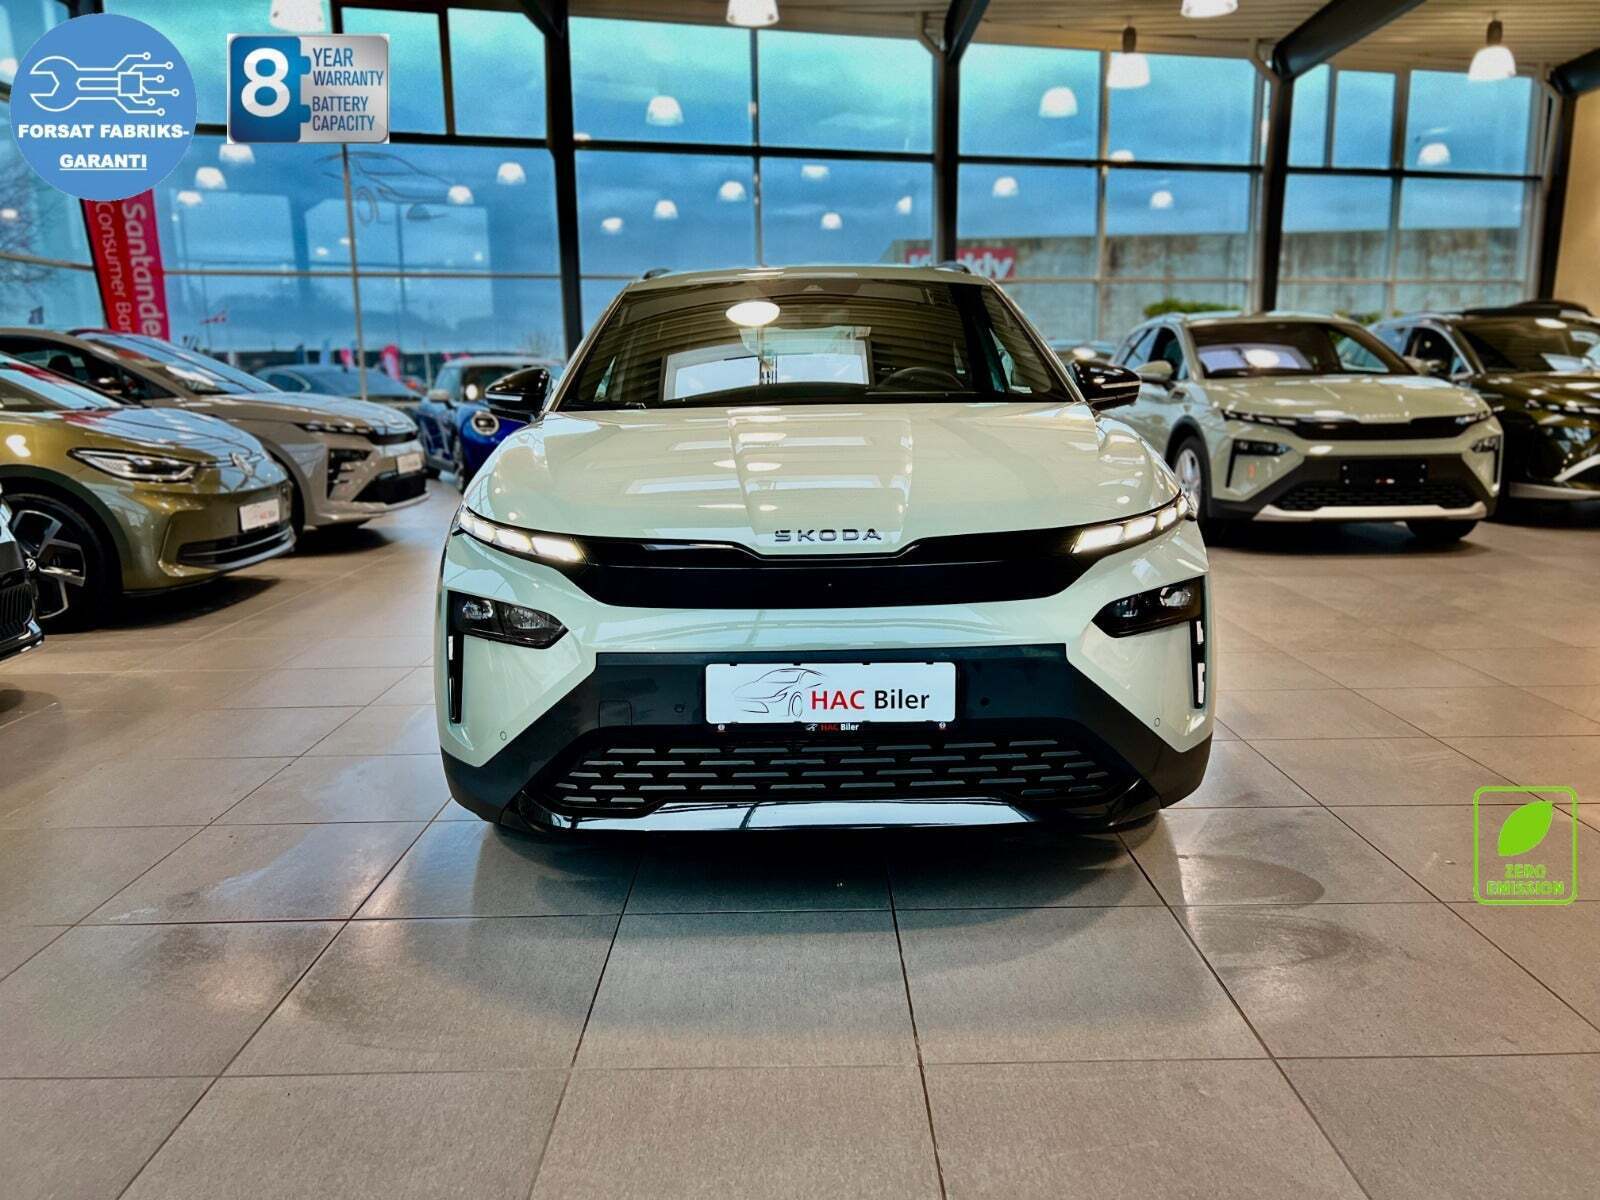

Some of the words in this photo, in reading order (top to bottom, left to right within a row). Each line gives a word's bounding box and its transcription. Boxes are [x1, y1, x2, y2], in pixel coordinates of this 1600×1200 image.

[95, 202, 127, 298] Consumer
[121, 202, 164, 336] Santande
[811, 690, 865, 710] HAC
[874, 689, 930, 710] Biler
[840, 722, 860, 732] Biler
